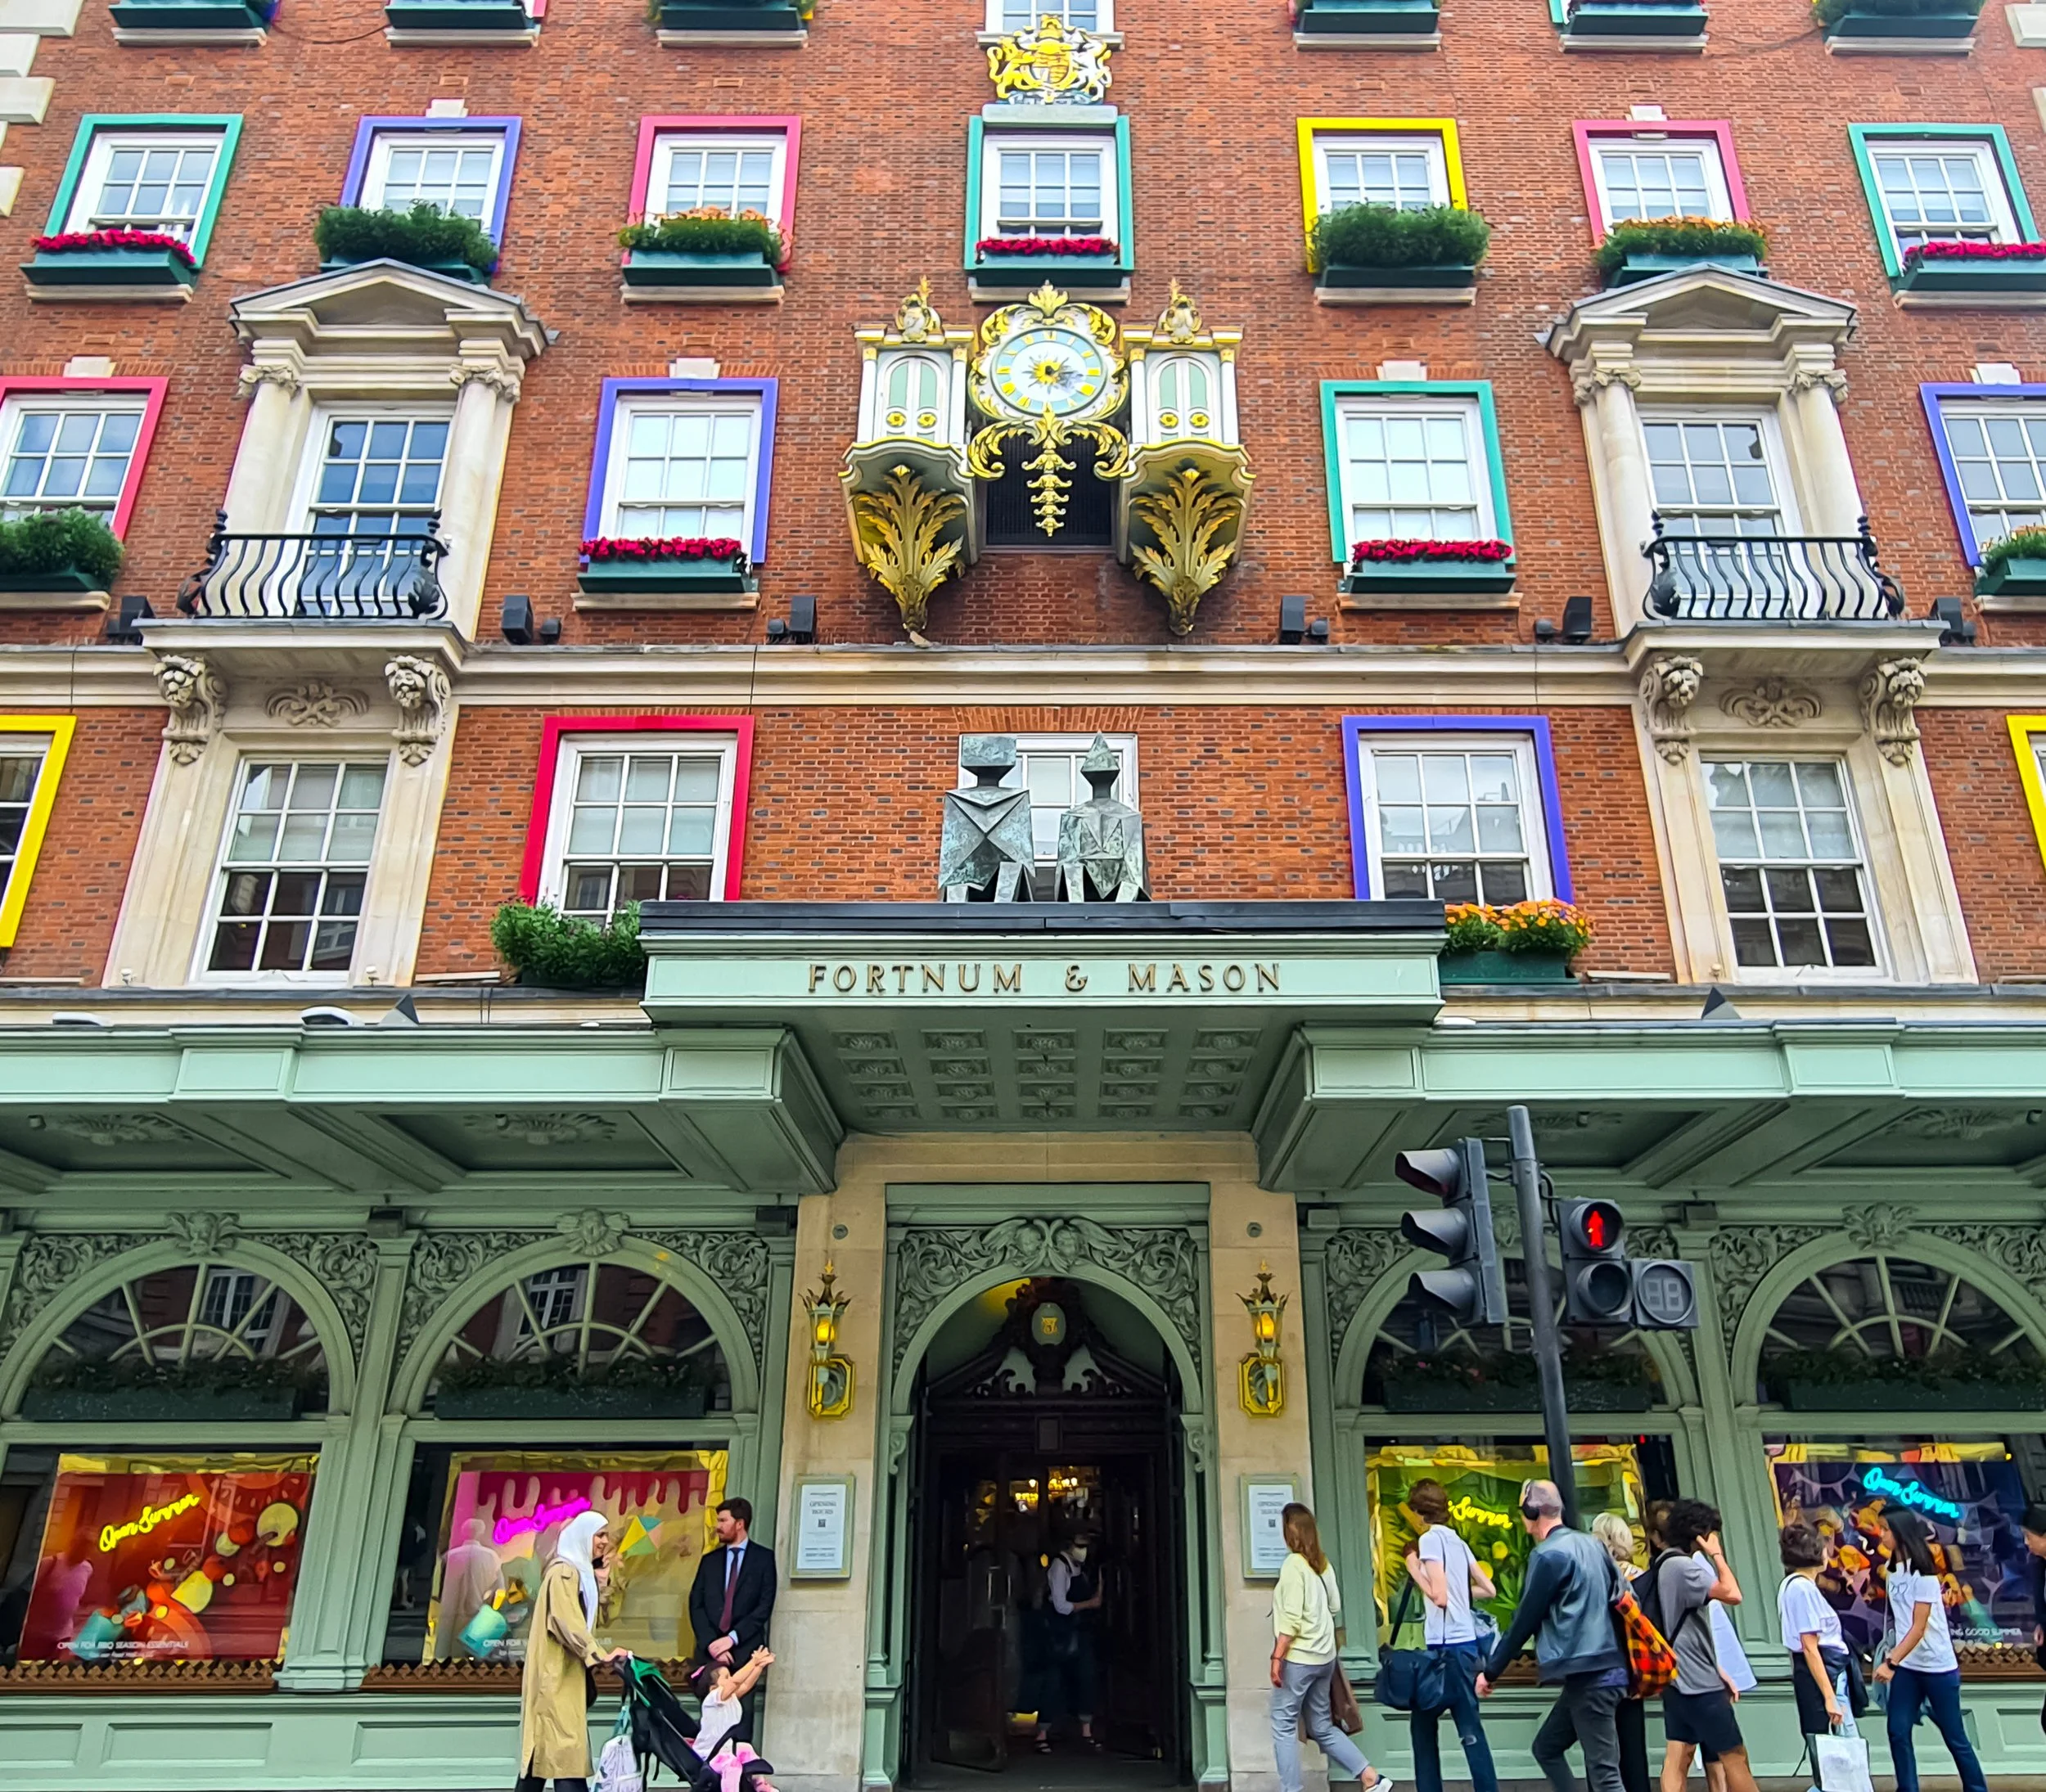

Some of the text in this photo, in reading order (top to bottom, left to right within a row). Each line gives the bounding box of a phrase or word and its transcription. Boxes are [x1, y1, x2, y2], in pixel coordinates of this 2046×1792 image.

[808, 962, 1281, 993] FORTNUM & MASON
